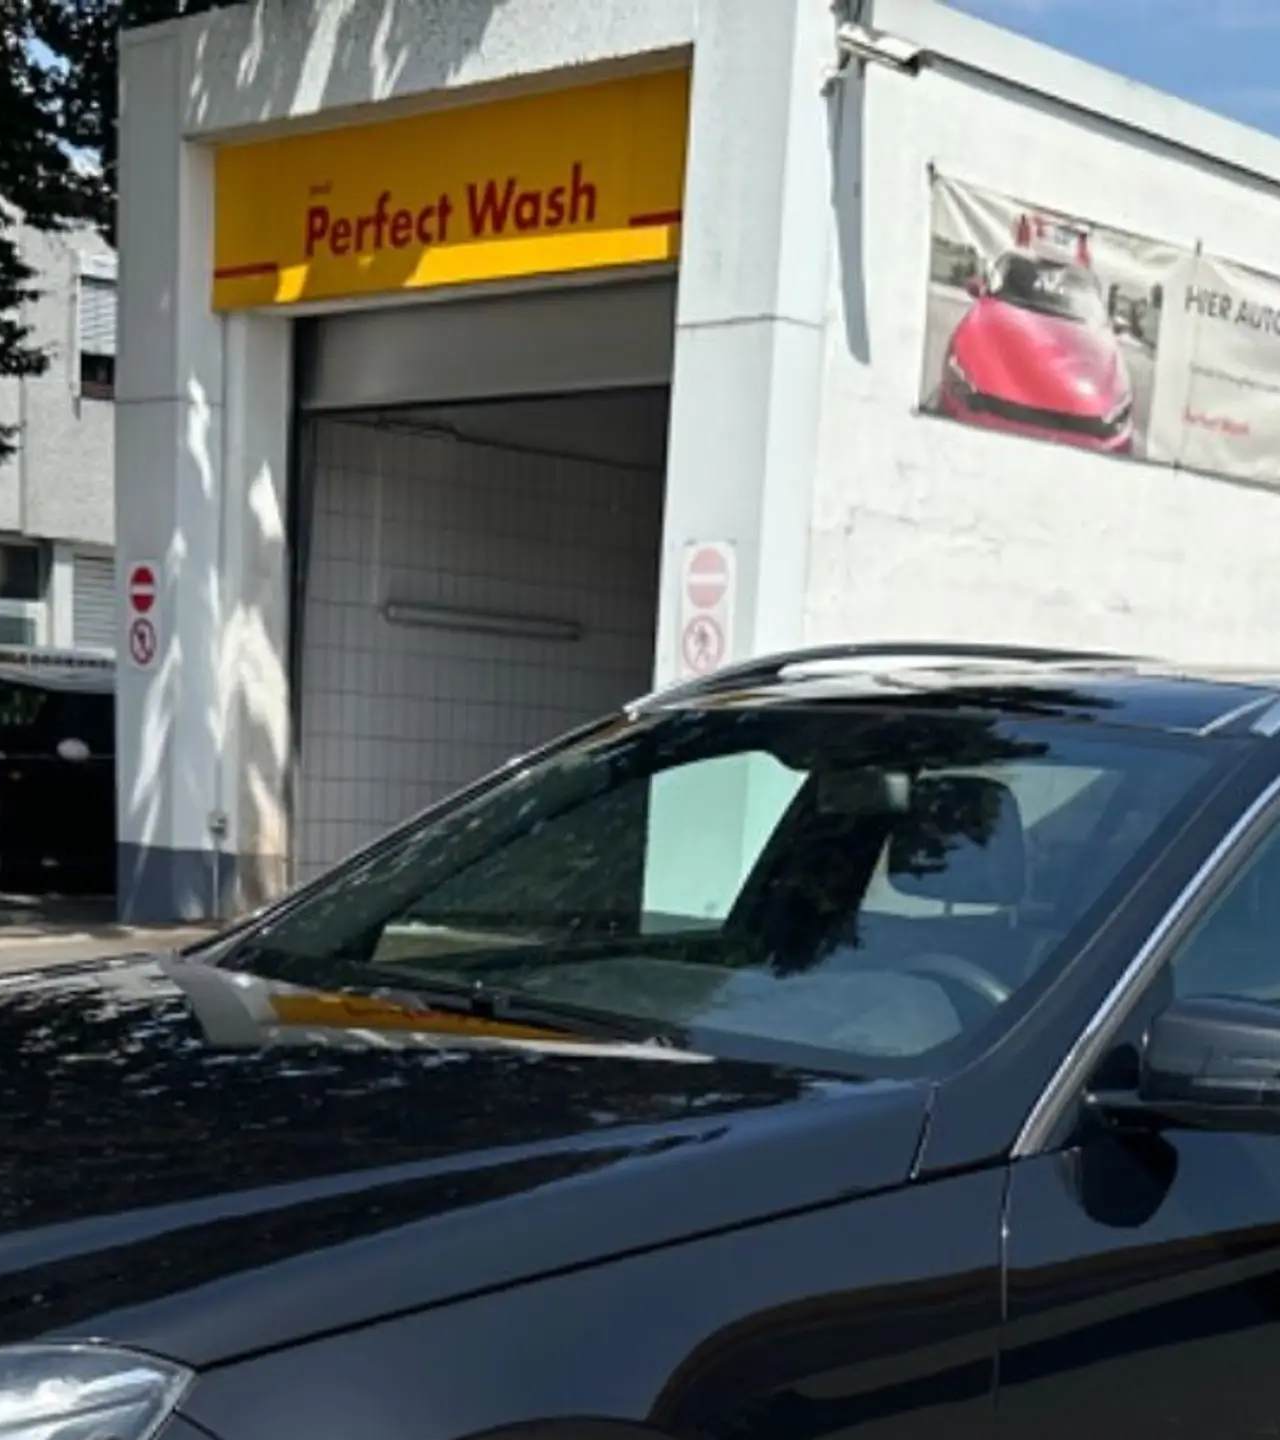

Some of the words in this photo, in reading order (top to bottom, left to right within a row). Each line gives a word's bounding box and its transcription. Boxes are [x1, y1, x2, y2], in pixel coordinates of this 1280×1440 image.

[303, 191, 453, 257] Perfect
[466, 161, 598, 237] Wash
[1185, 285, 1233, 321] HIER
